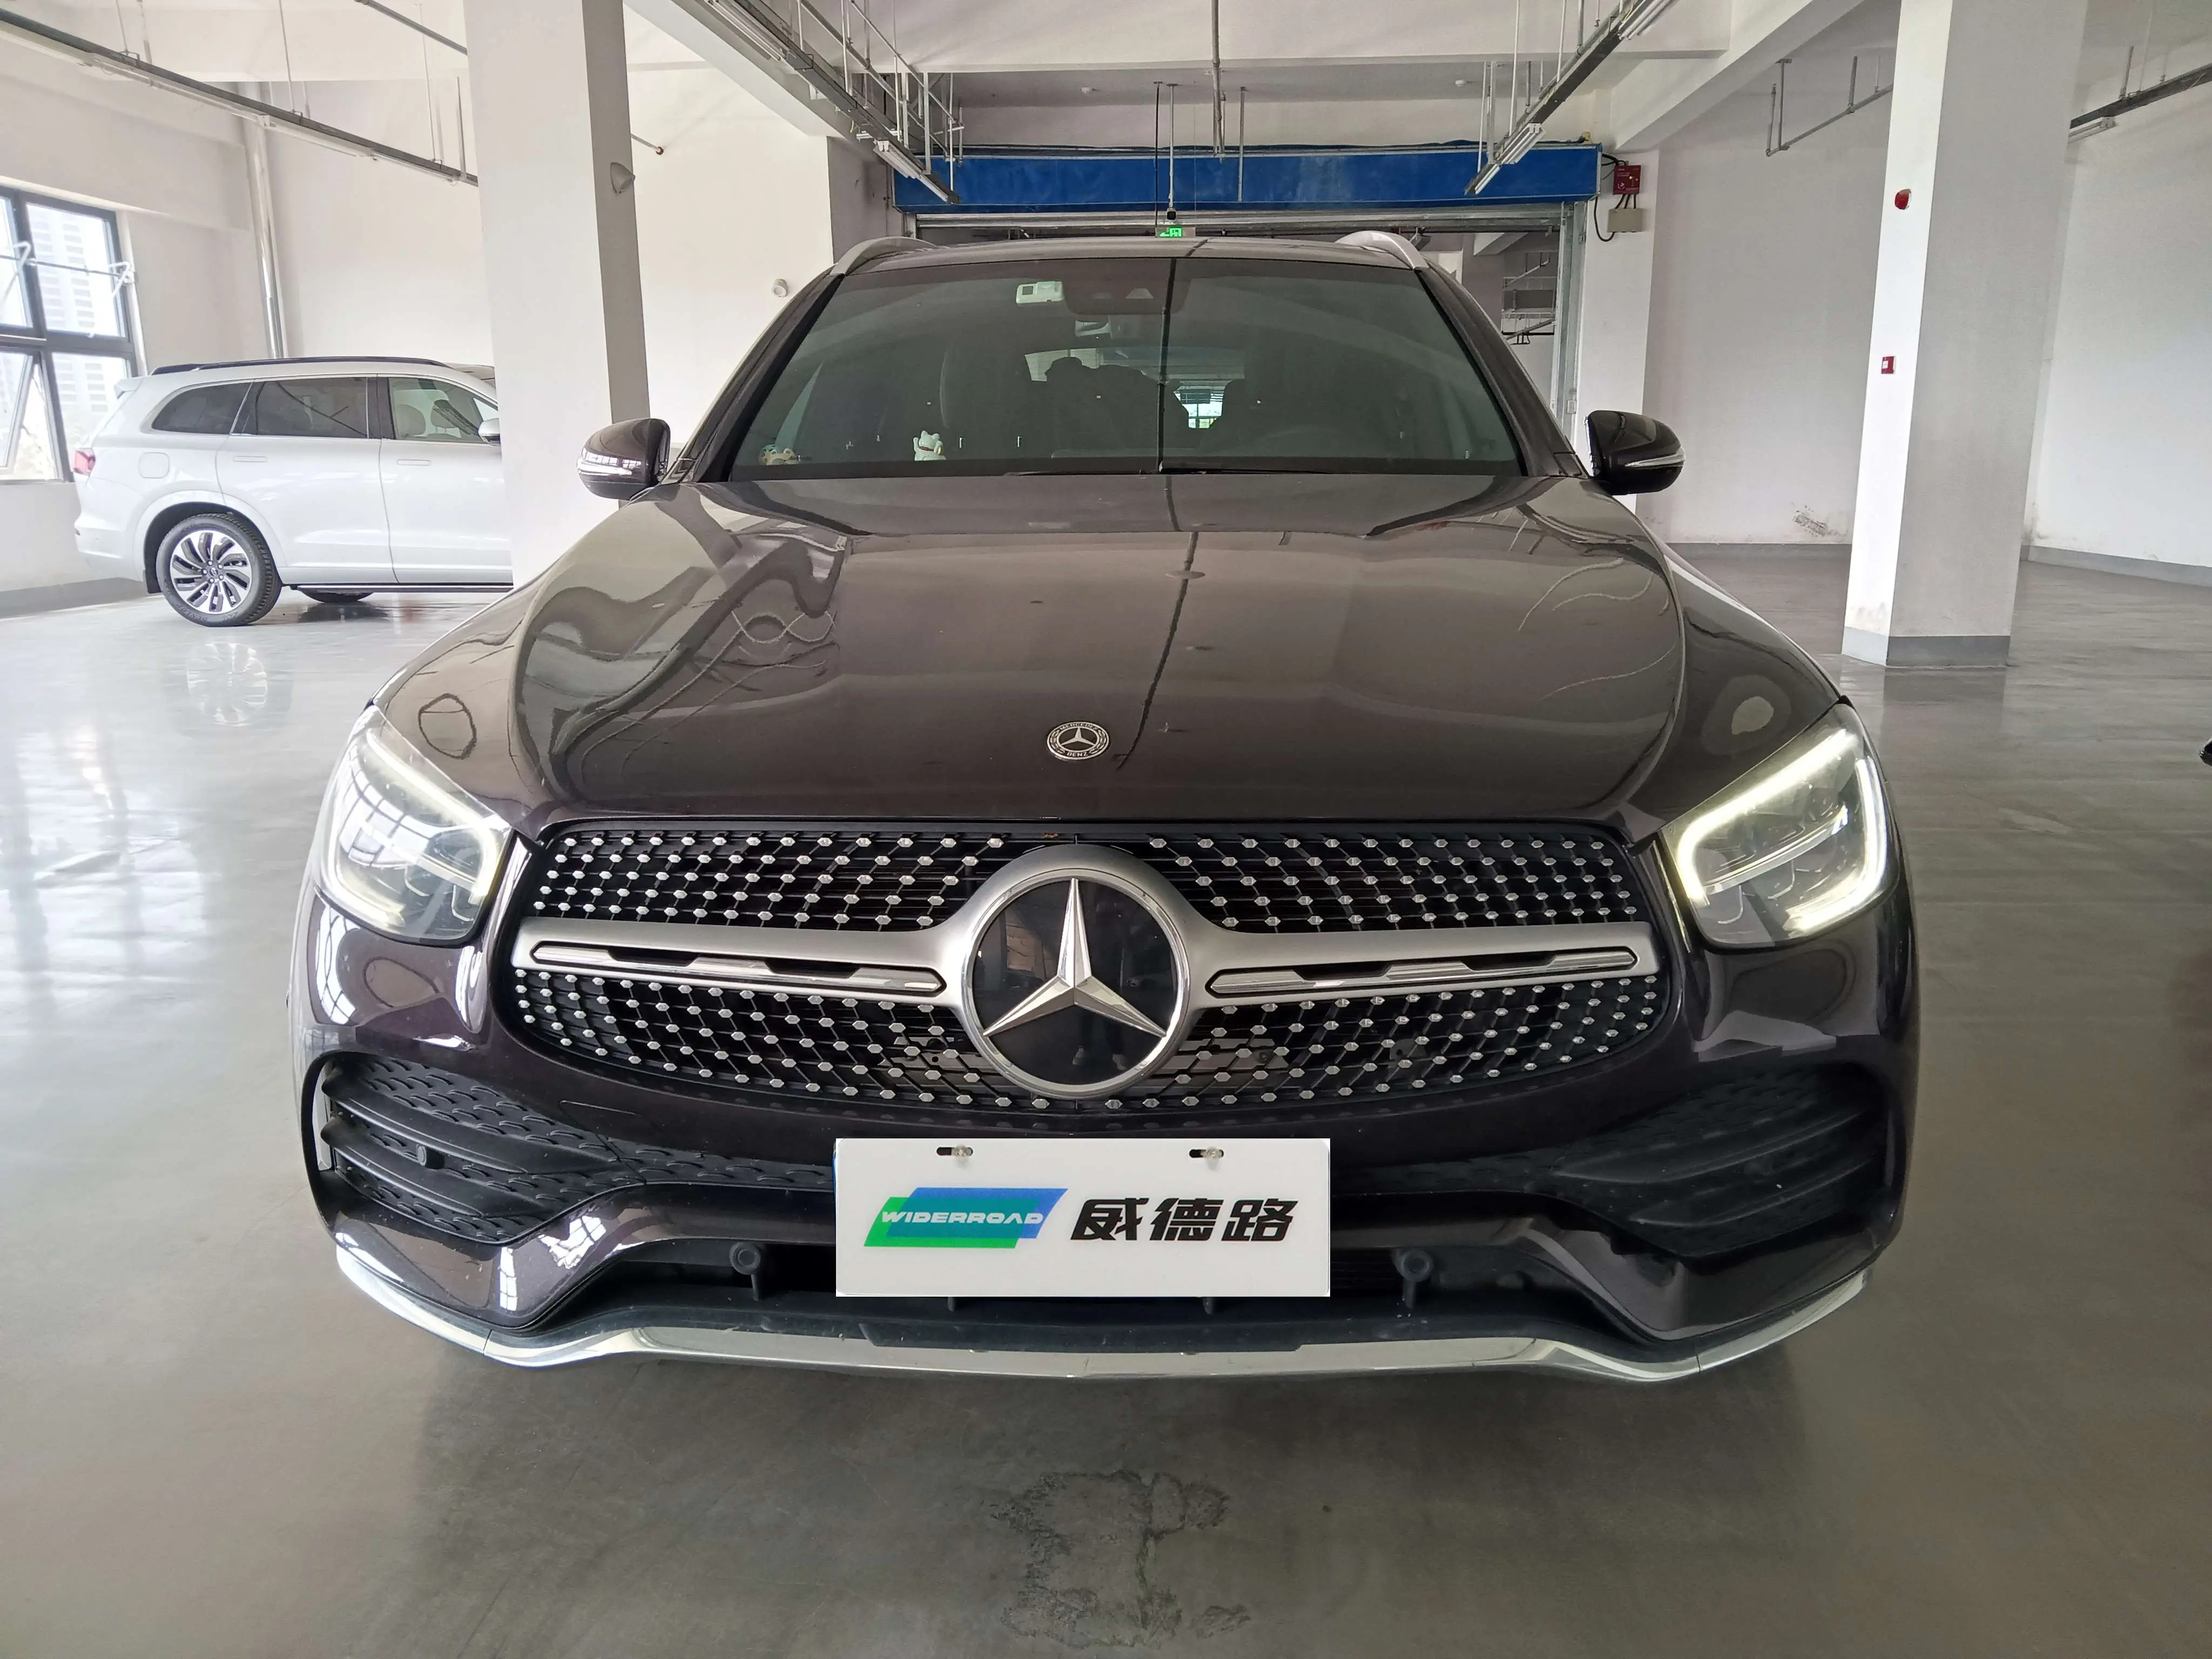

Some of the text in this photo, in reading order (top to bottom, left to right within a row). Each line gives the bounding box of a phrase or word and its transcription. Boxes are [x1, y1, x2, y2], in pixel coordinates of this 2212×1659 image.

[882, 1211, 1043, 1224] WIDERROAD
[1070, 1198, 1298, 1241] 威德路
